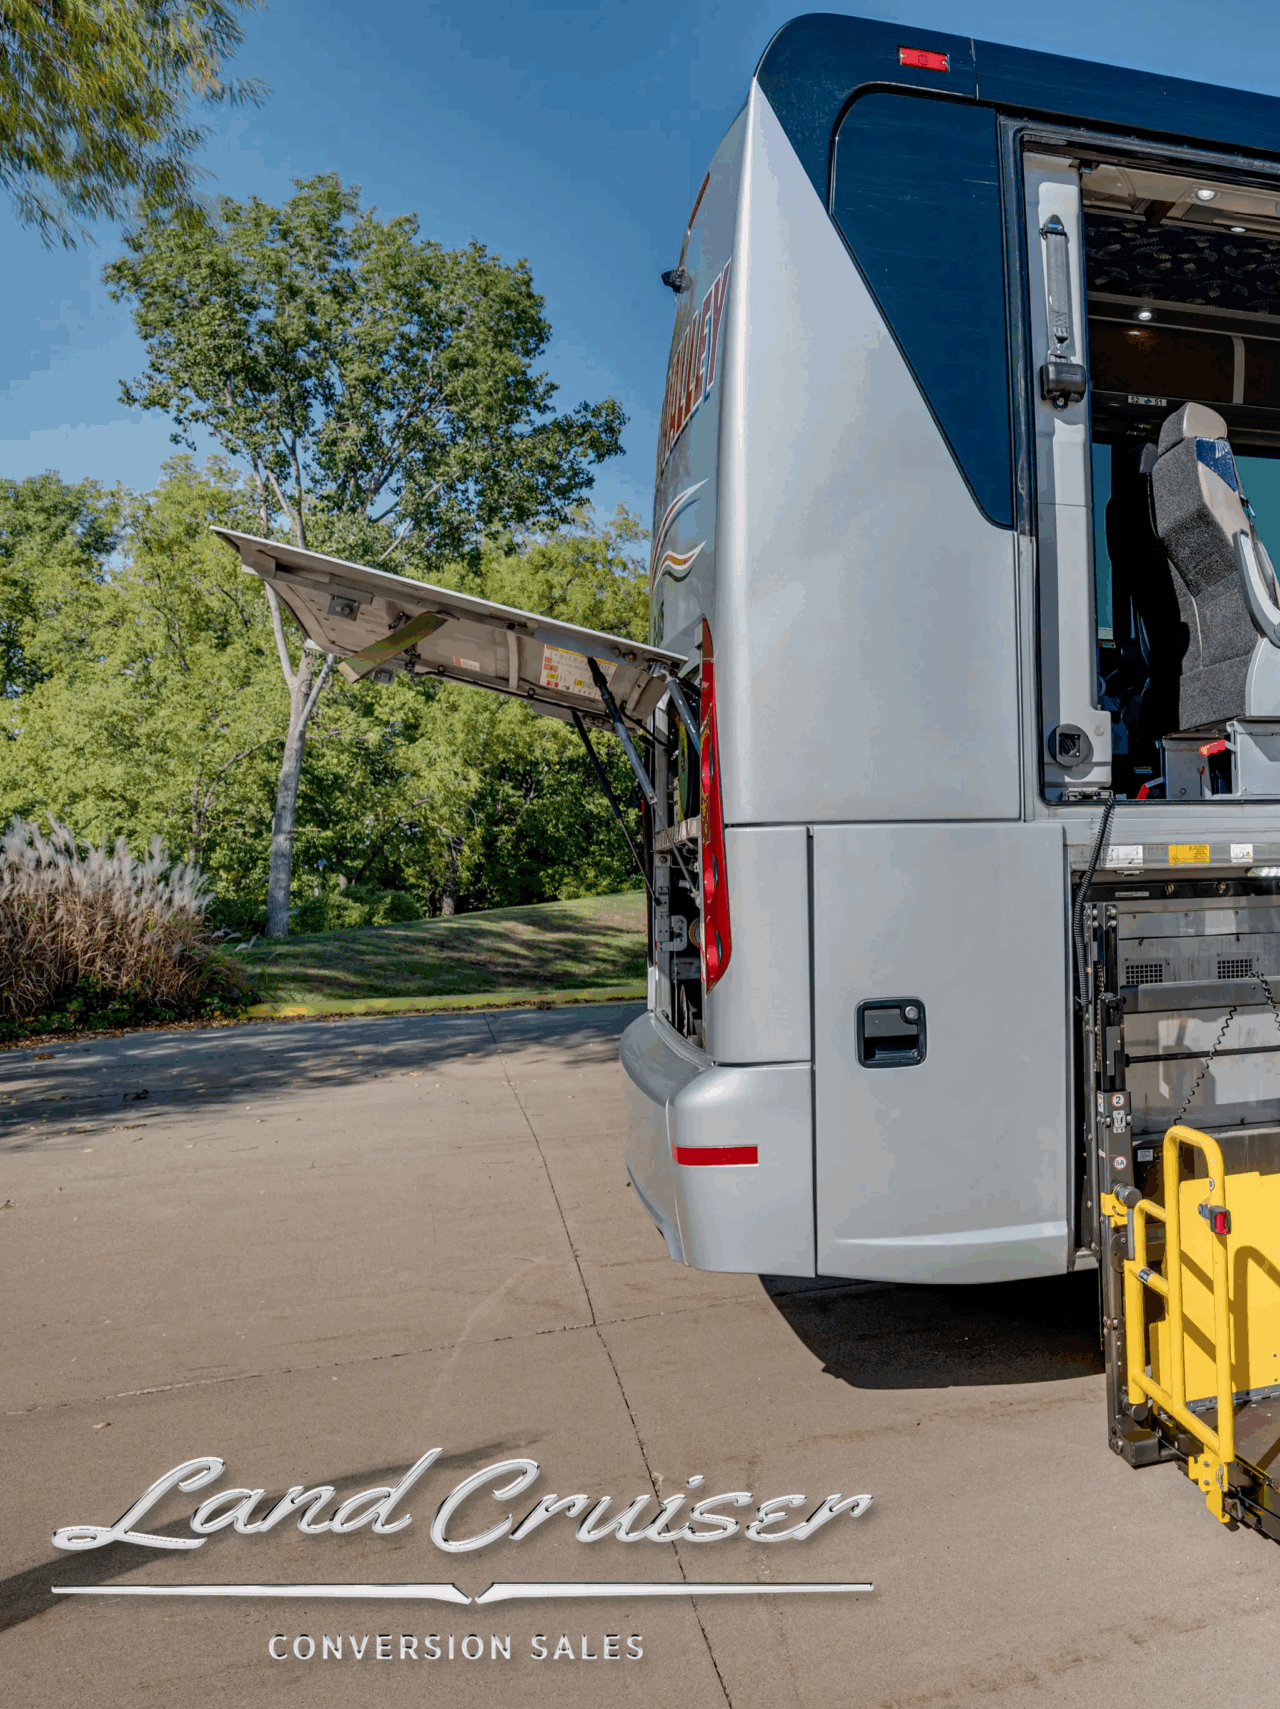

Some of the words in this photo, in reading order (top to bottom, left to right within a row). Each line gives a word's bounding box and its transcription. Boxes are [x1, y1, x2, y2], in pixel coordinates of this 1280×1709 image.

[1131, 396, 1140, 404] 52
[1154, 398, 1163, 406] 51
[1115, 1159, 1125, 1167] 5A
